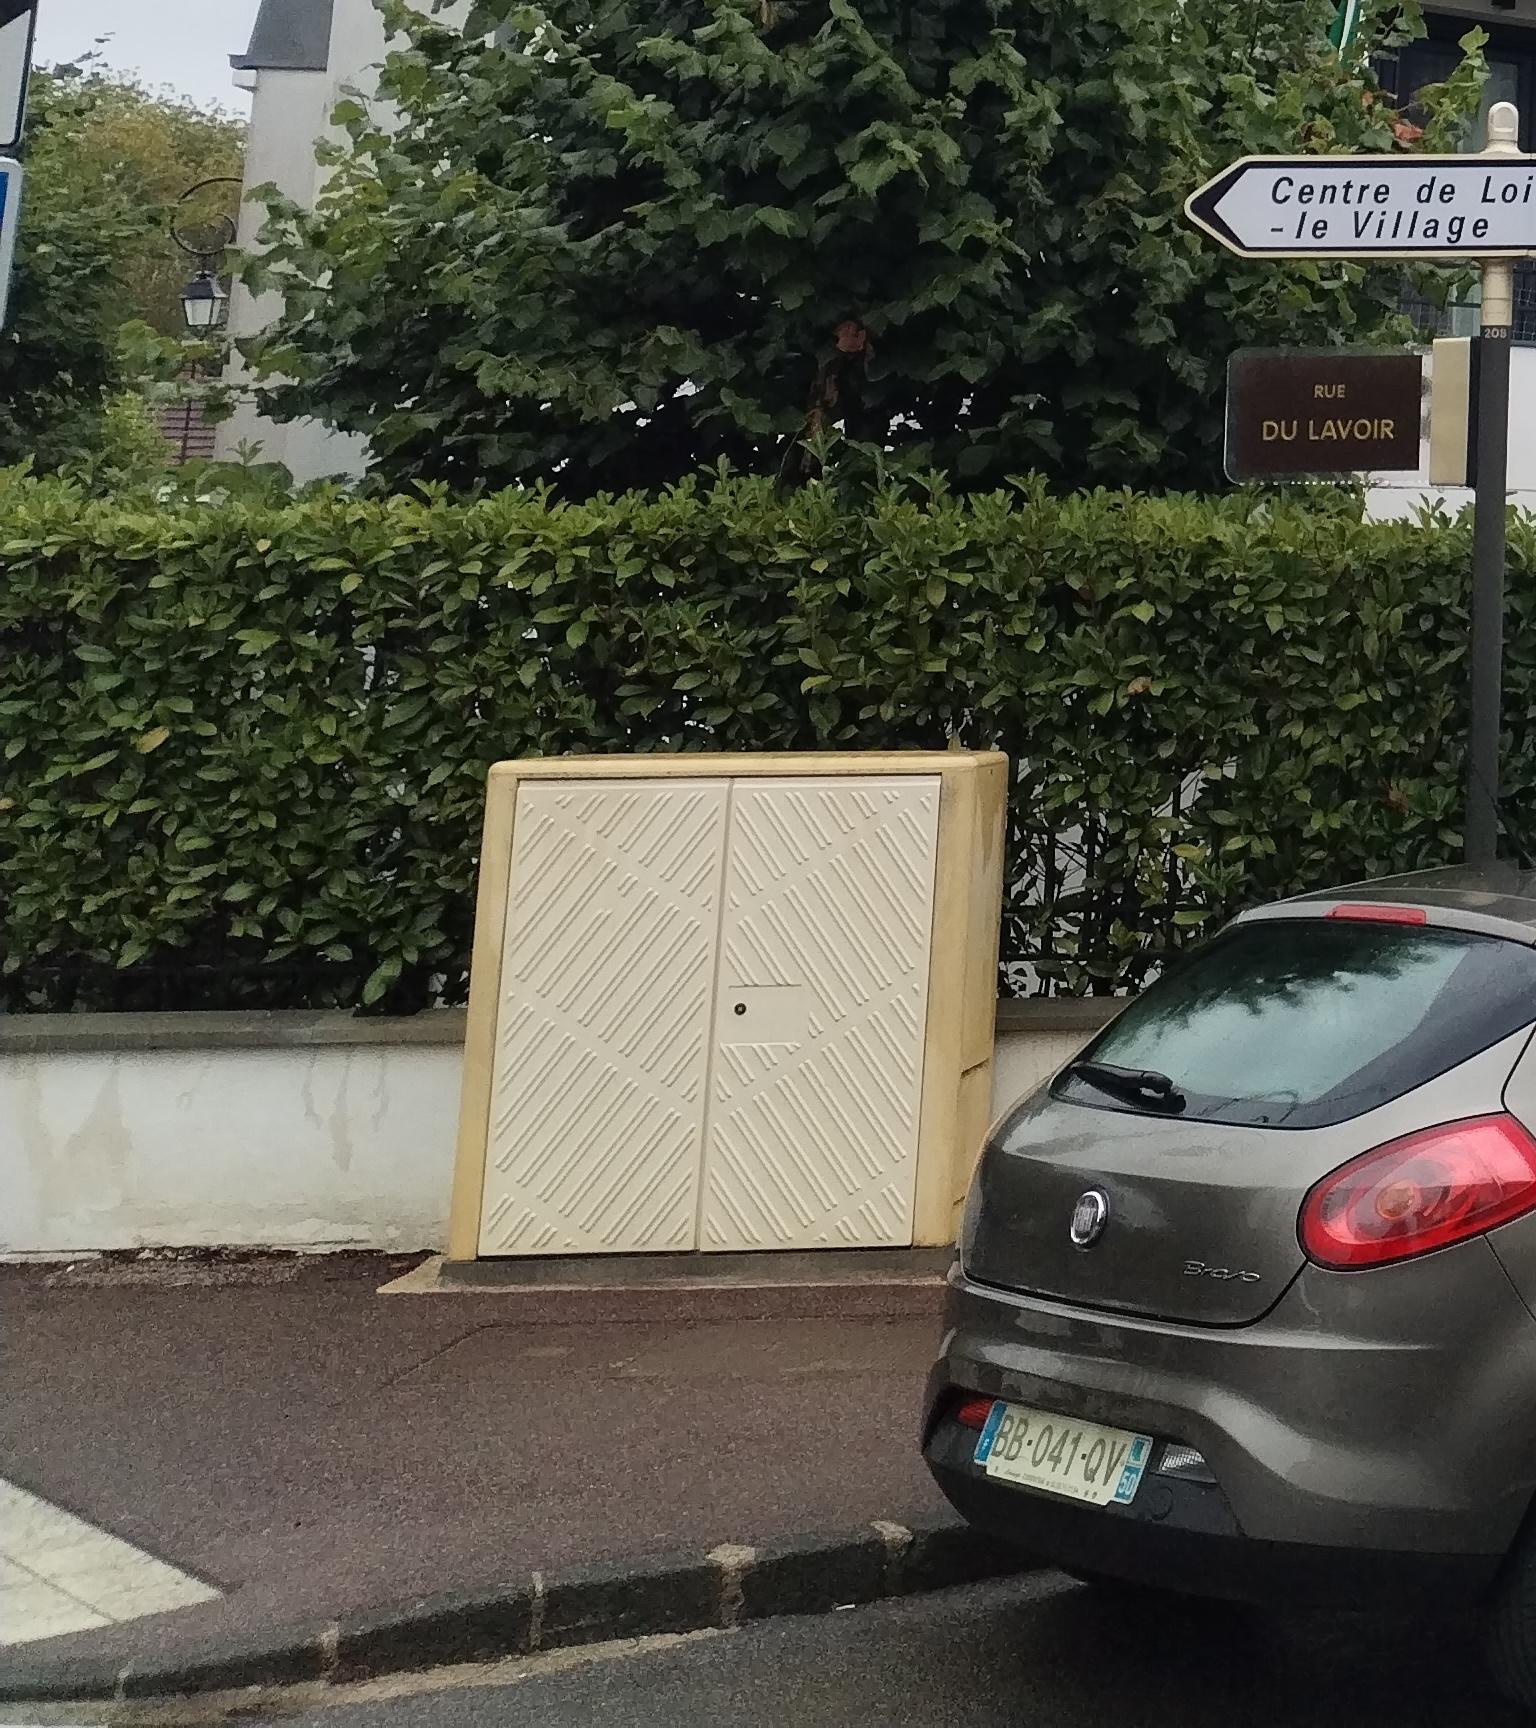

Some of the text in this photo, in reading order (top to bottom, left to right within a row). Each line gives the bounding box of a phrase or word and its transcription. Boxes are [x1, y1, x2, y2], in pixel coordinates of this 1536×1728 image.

[1271, 176, 1390, 205] Centre
[1416, 176, 1456, 204] de
[1353, 210, 1489, 244] Village
[1314, 384, 1346, 399] RUE
[1262, 419, 1394, 441] DU LAVOIR
[991, 1413, 1128, 1487] BB-041-QV
